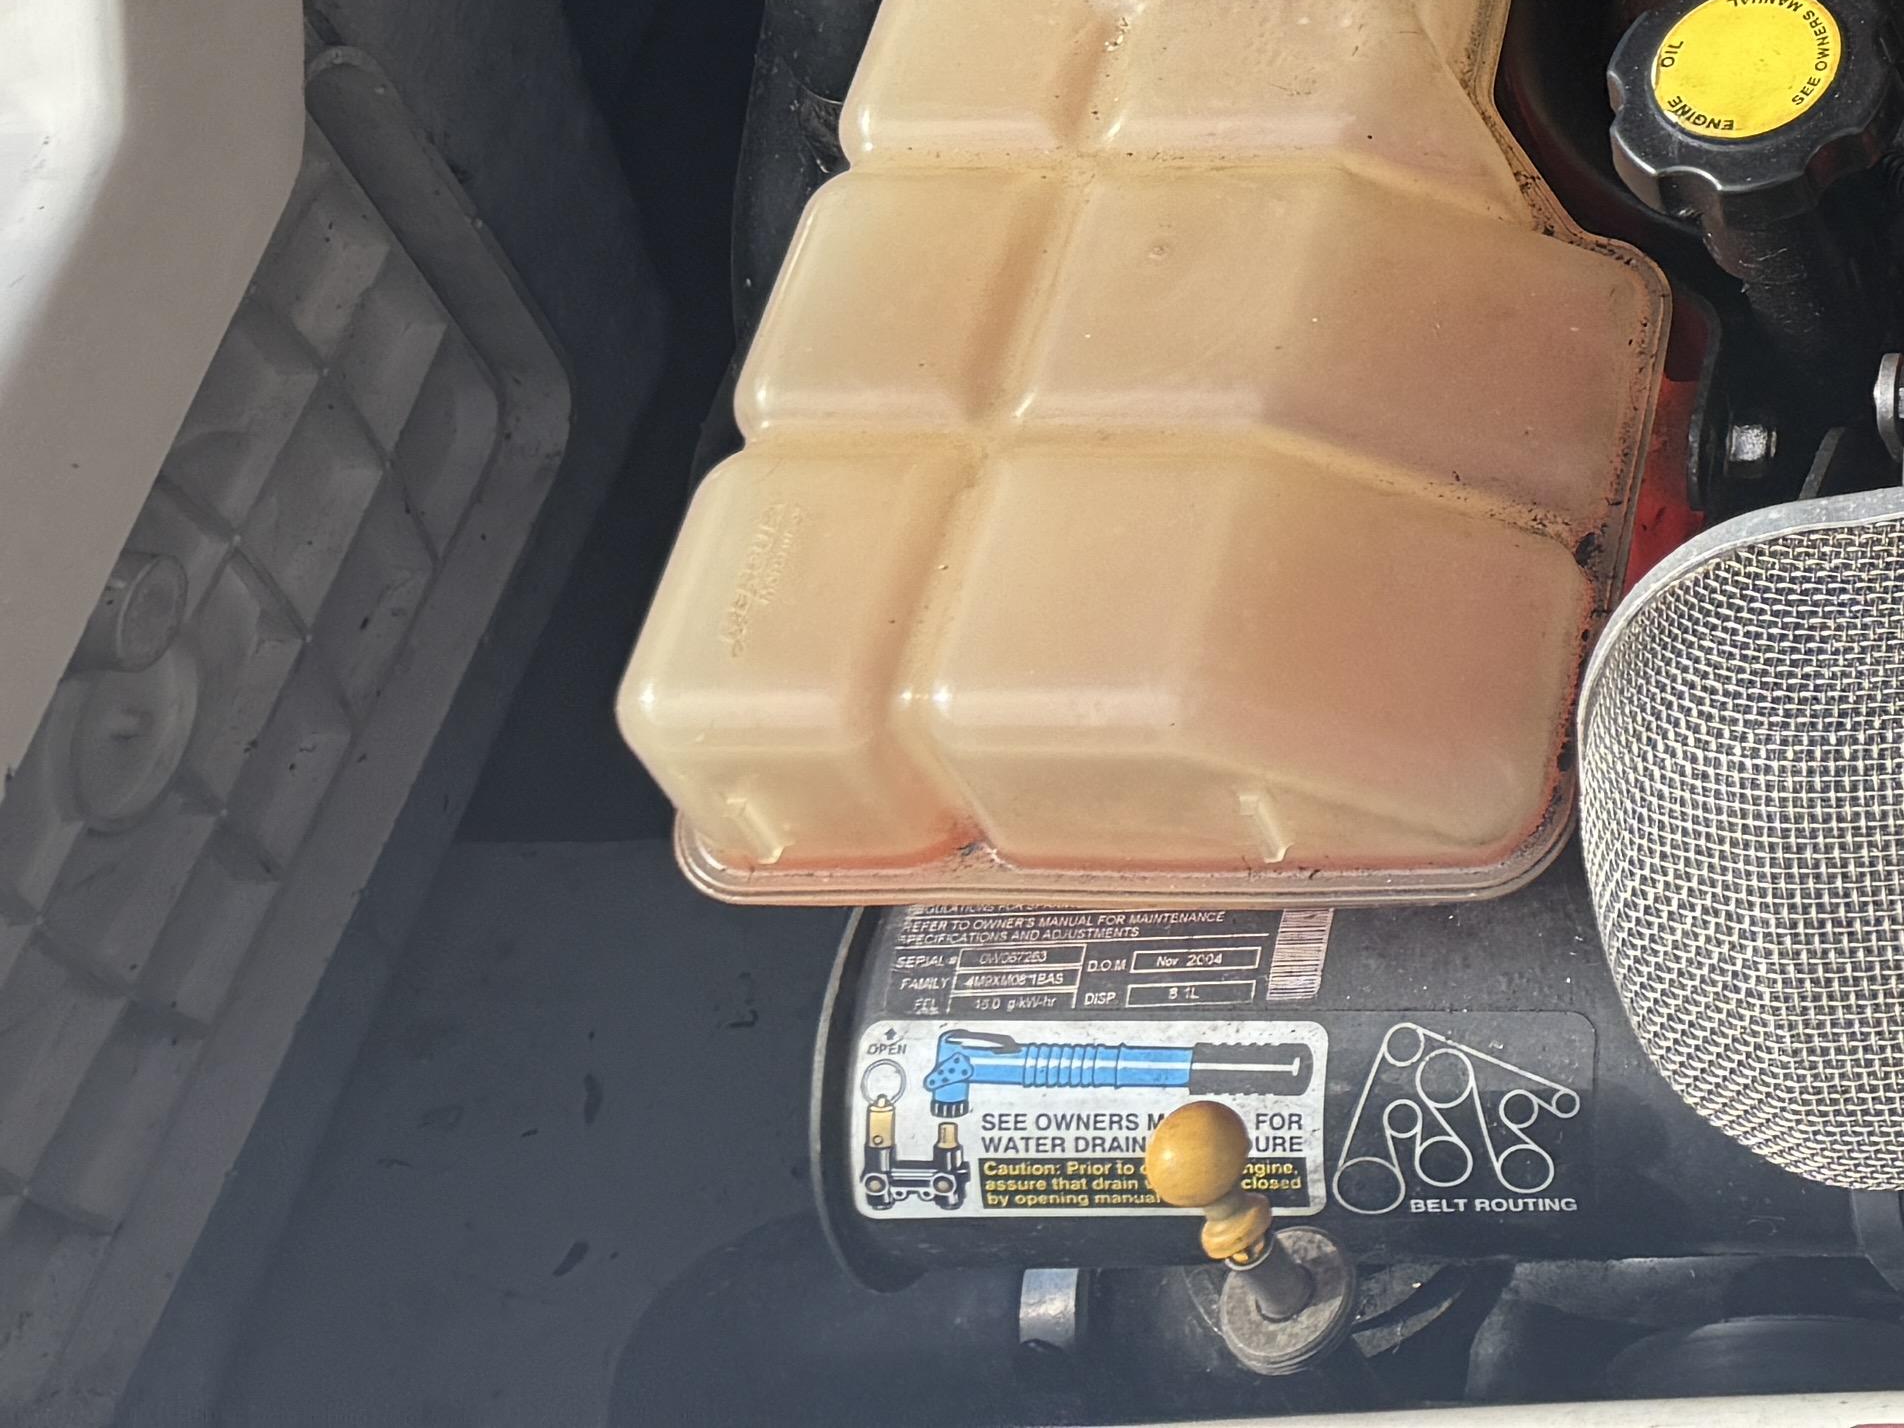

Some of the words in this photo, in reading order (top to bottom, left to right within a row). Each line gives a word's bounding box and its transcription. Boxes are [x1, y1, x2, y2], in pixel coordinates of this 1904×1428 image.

[1802, 10, 1830, 72] OWNERS
[1660, 39, 1685, 69] OIL
[1791, 76, 1820, 106] SEE
[1666, 94, 1735, 131] ENGINE
[903, 919, 947, 932] REFER
[951, 920, 970, 931] TO
[973, 917, 1036, 930] OWNER'S
[1038, 915, 1093, 928] MANUAL
[1098, 914, 1125, 926] FOR
[1128, 911, 1226, 924] MAINTENANCE
[898, 929, 1008, 944] SPECIFICATIONS
[1011, 928, 1039, 941] AND
[1043, 926, 1140, 940] ADJUSTMENTS
[896, 955, 945, 969] SERIAL
[1156, 955, 1179, 968] Nov
[1185, 952, 1223, 967] 2004
[899, 976, 951, 991] FAMILY
[866, 1043, 907, 1056] OPEN
[981, 1112, 1028, 1131] SEE
[1035, 1112, 1140, 1131] OWNERS
[1255, 1112, 1303, 1131] FOR
[981, 1135, 1066, 1154] WATER
[983, 1160, 1061, 1176] Caution:
[1066, 1160, 1112, 1176] Prior
[1116, 1160, 1135, 1175] to
[985, 1178, 1047, 1191] assure
[1051, 1176, 1088, 1191] that
[1092, 1177, 1138, 1191] drain
[1240, 1176, 1302, 1190] closed
[987, 1193, 1009, 1207] by
[1014, 1192, 1090, 1207] opening
[1409, 1198, 1468, 1213] BELT
[1474, 1197, 1578, 1212] ROUTING
